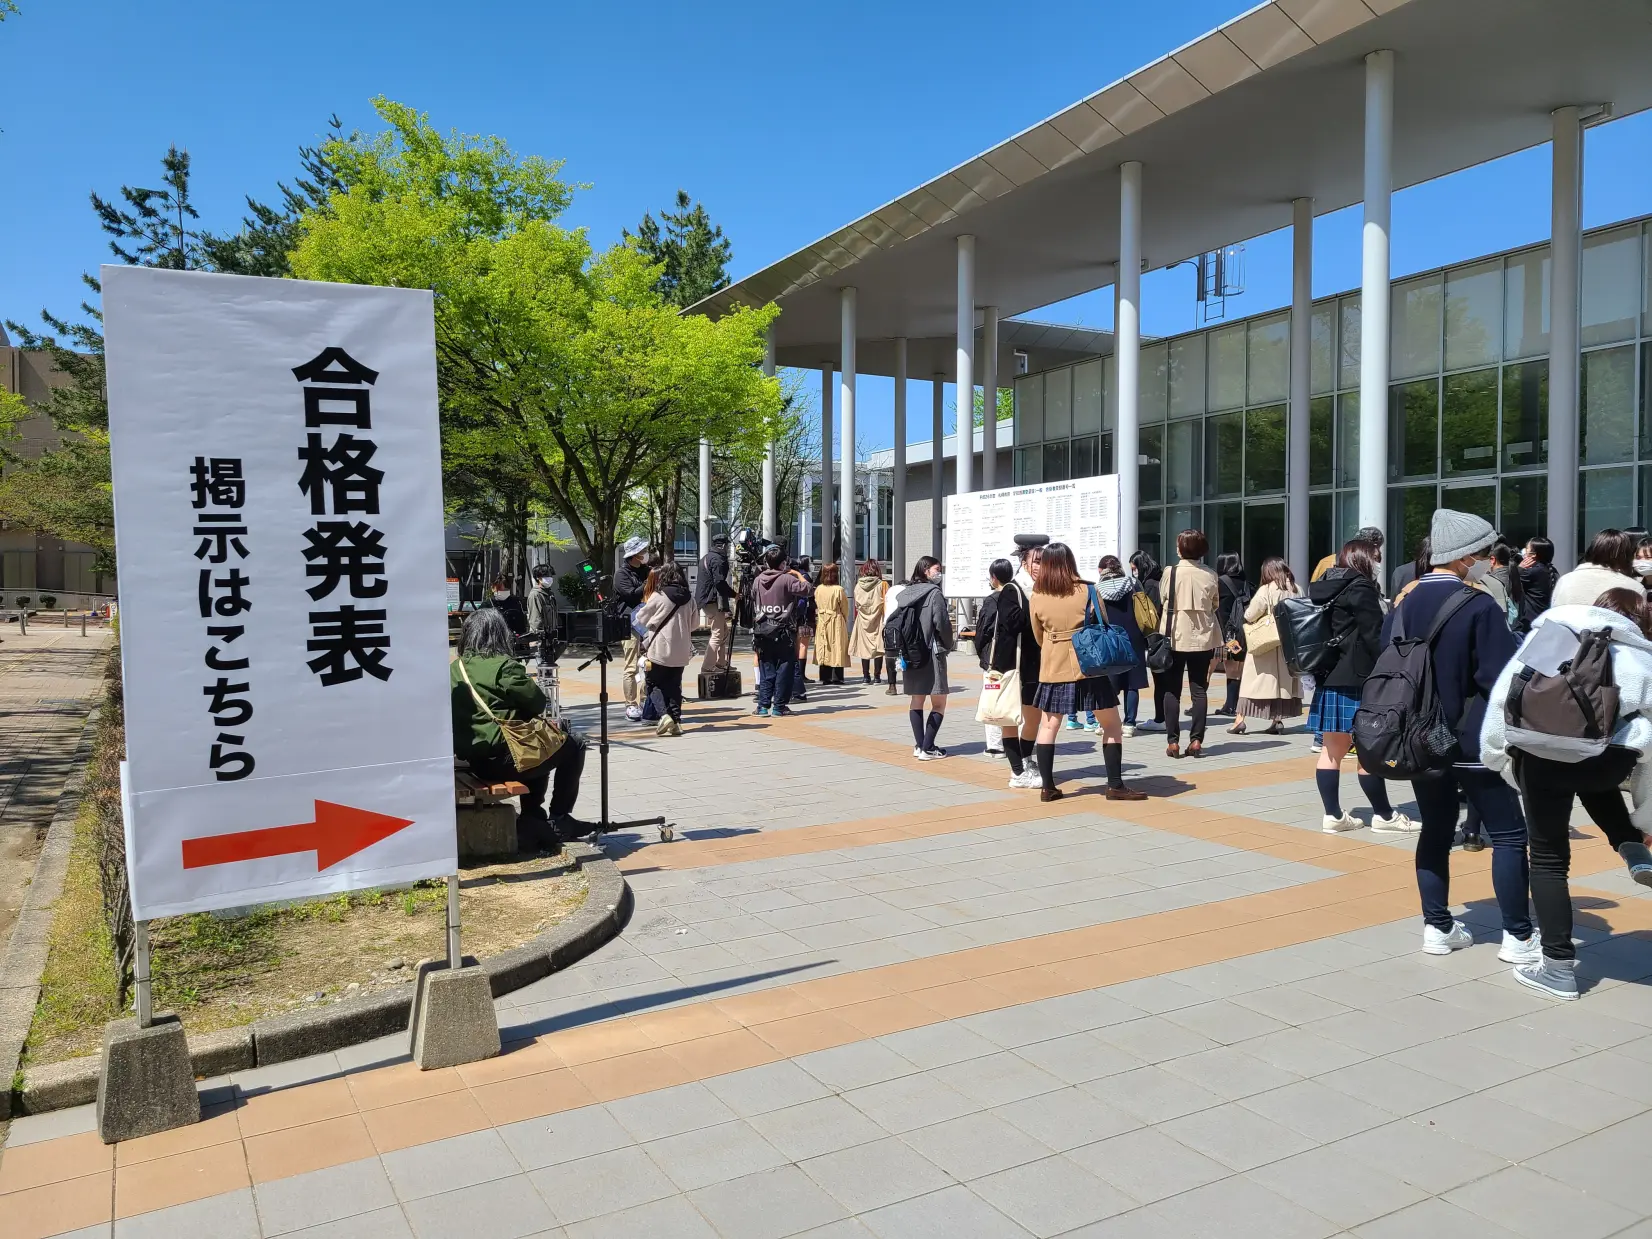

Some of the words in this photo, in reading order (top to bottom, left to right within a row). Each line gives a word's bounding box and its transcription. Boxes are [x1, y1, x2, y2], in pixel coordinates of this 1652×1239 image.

[189, 456, 256, 782] 掲示はこちら
[291, 346, 394, 688] 合格発表
